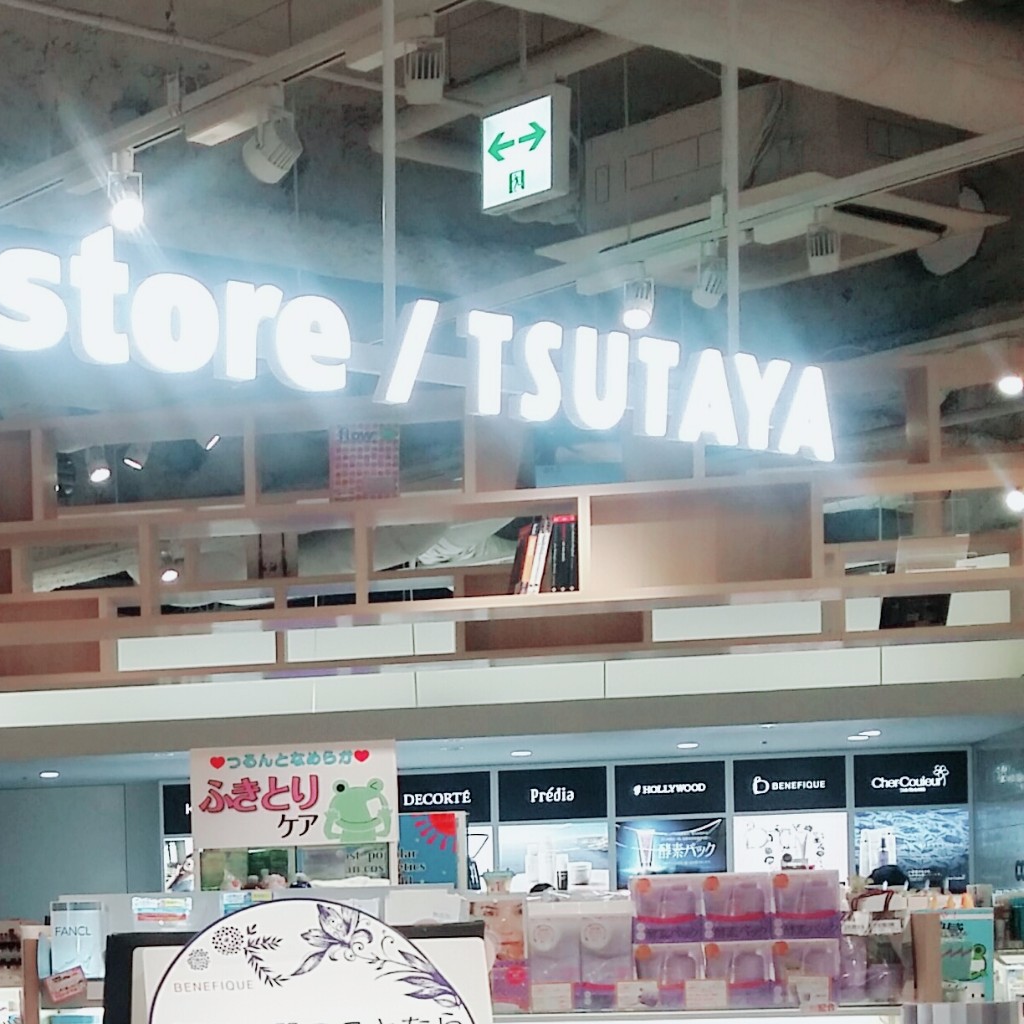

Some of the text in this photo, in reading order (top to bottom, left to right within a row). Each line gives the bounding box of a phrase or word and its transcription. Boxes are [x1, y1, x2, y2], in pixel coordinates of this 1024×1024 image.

[467, 310, 836, 461] TSUTAYA
[227, 750, 353, 769] つるんとなめらか
[199, 775, 319, 813] ふきとり
[642, 783, 706, 795] HOLLYWOOD
[771, 780, 826, 791] BENEFIQUE
[403, 789, 472, 806] DECORTÉ
[530, 786, 575, 803] Prédia
[277, 814, 319, 838] ケア
[657, 842, 716, 859] 酵素パック
[55, 926, 92, 937] FANCL
[173, 979, 253, 993] BENEFIQUE
